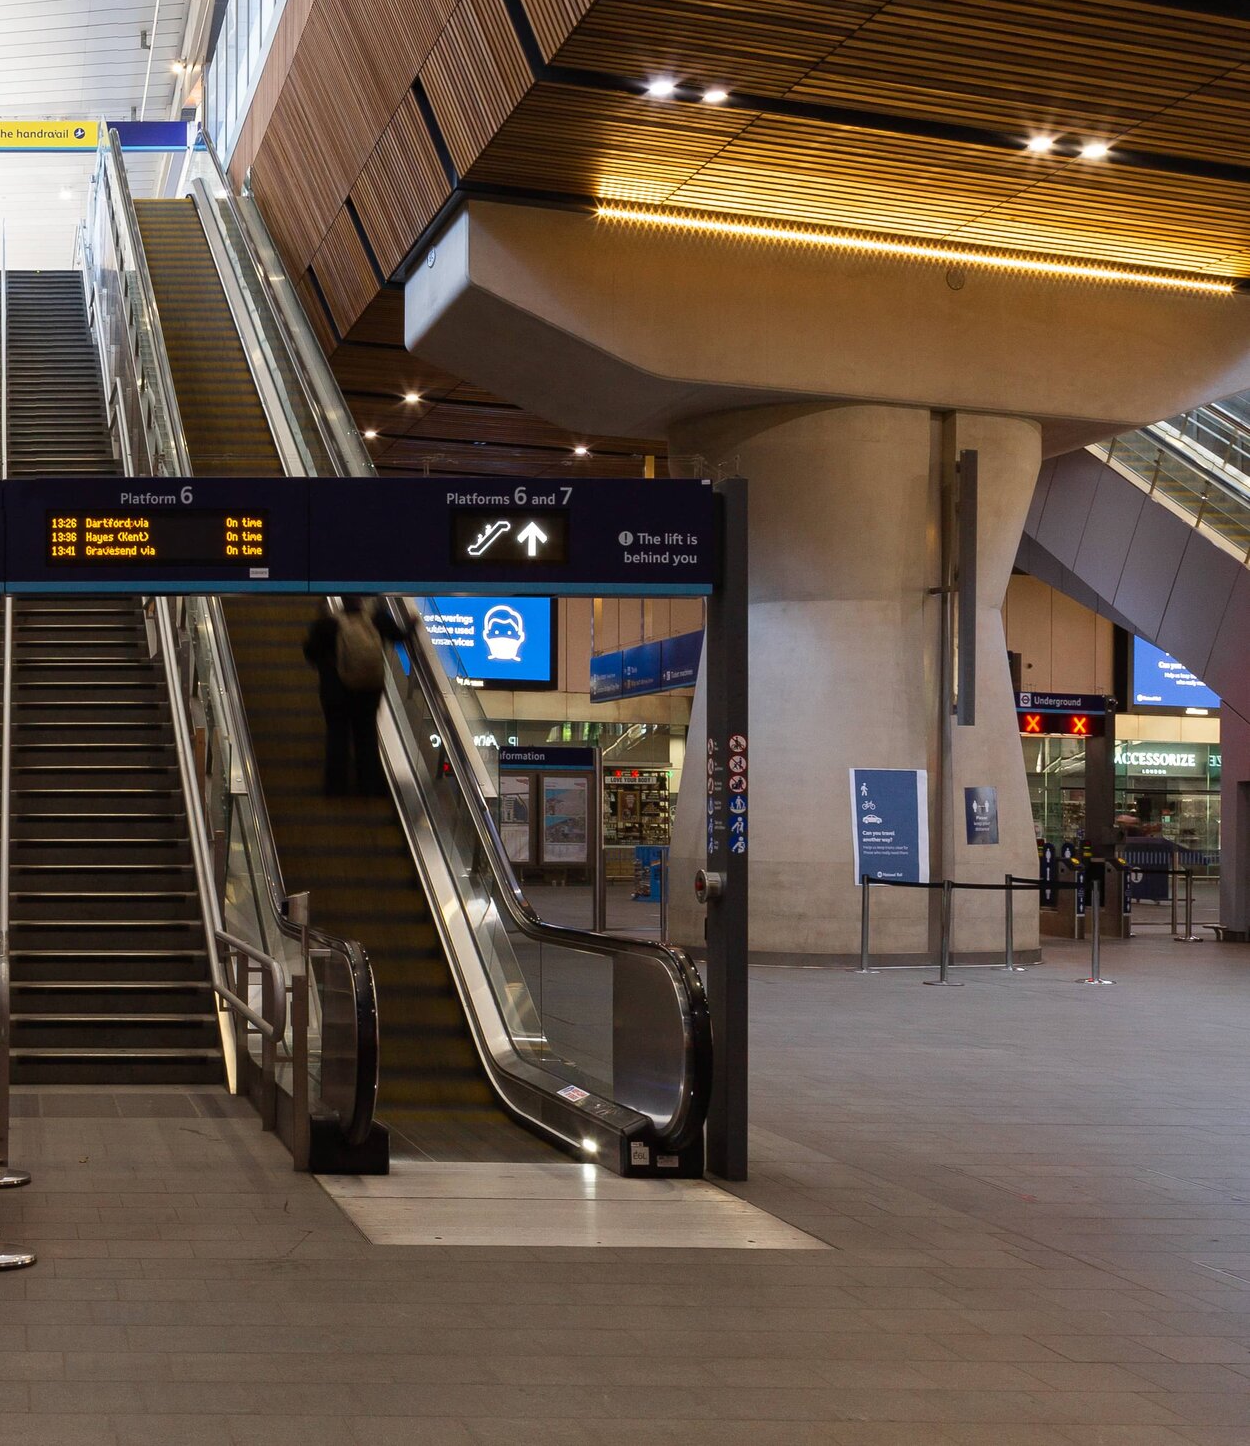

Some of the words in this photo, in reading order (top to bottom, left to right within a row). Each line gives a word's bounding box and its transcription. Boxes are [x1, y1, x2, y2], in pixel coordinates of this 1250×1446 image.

[120, 492, 176, 504] Platform
[180, 486, 193, 504] 6
[446, 493, 510, 505] Platforms
[514, 486, 527, 504] 6
[531, 493, 556, 505] and
[559, 487, 573, 504] 7
[52, 518, 77, 528] 13:26
[86, 518, 130, 528] Dartford
[134, 518, 149, 528] via
[226, 518, 238, 528] On
[242, 518, 262, 528] time
[52, 532, 77, 542] 13:36
[86, 532, 114, 544] Hayes
[117, 532, 149, 542] (Kent)
[226, 532, 238, 542] On
[242, 532, 262, 542] time
[637, 533, 661, 545] The
[664, 532, 683, 544] lift
[687, 533, 698, 544] is
[52, 546, 76, 556] 13:41
[86, 546, 137, 556] Gravesend
[140, 546, 156, 556] via
[226, 546, 238, 556] On
[242, 546, 262, 556] time
[624, 552, 669, 564] behind
[672, 554, 698, 566] you
[454, 626, 475, 635] used
[1034, 696, 1081, 709] Underground
[499, 751, 545, 761] formation
[1114, 752, 1196, 767] ACCESSORIZE
